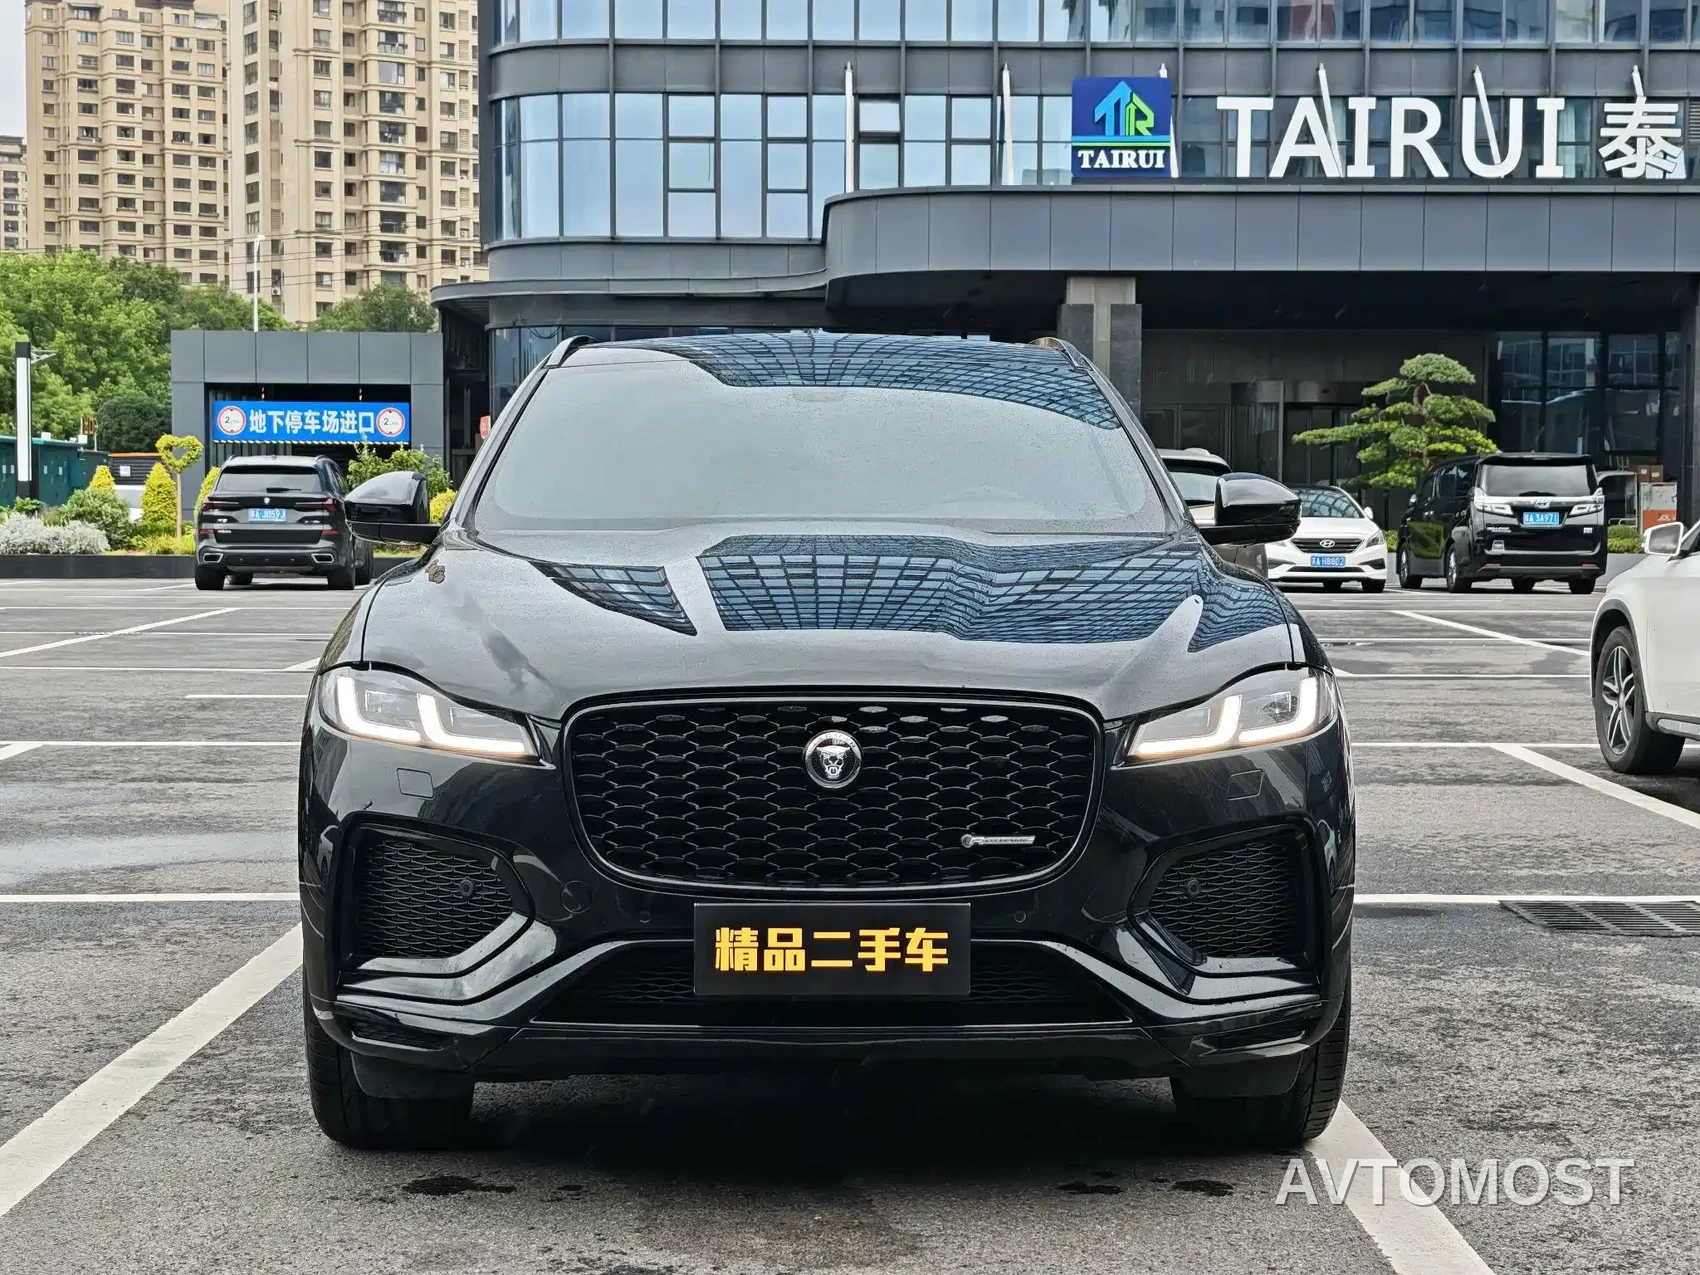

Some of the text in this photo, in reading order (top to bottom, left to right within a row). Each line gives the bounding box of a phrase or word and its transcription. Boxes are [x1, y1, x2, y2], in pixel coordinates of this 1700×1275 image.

[1078, 149, 1165, 169] TAIRUI
[1217, 96, 1565, 178] TAIRUI
[1599, 97, 1682, 178] 泰
[250, 409, 375, 435] 地下停车场进口
[715, 927, 949, 972] 精品二手车
